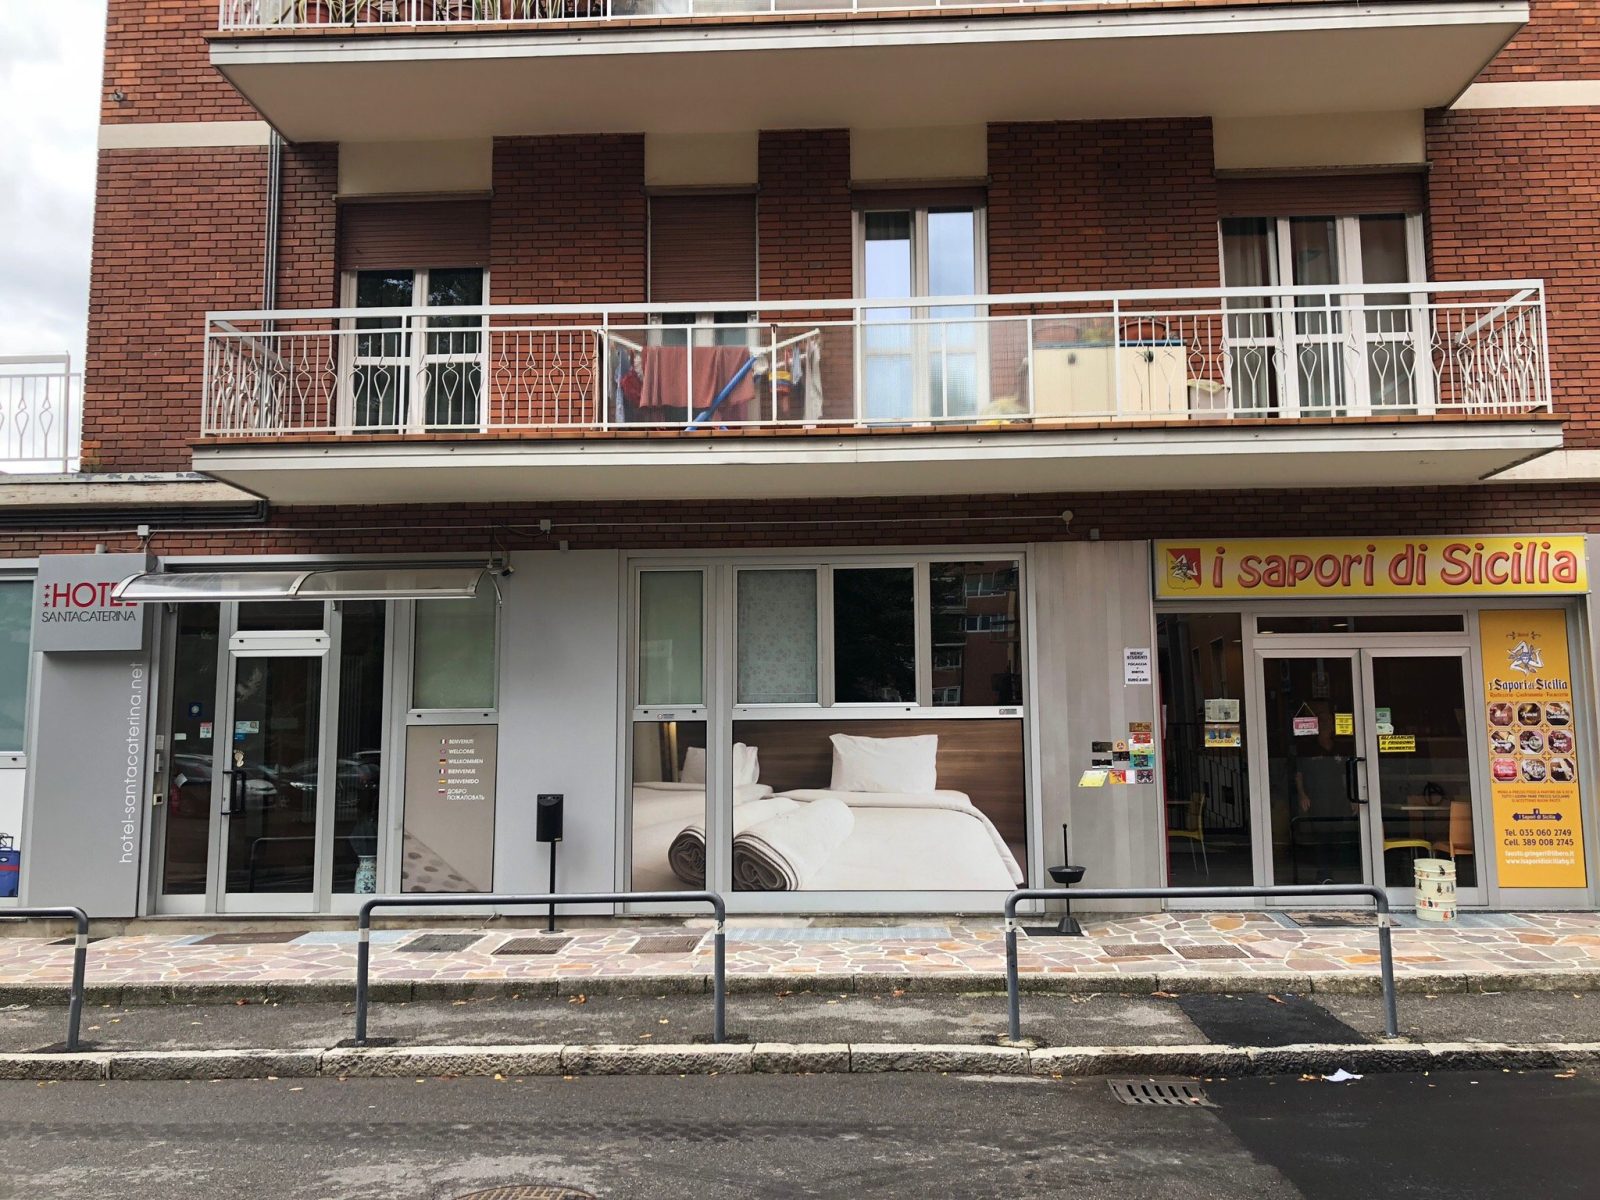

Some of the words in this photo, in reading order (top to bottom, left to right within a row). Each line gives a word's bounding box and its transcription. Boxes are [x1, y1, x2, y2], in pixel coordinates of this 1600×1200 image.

[1212, 546, 1226, 588] i
[1237, 544, 1376, 588] sapori
[1388, 543, 1428, 587] di
[1440, 541, 1578, 586] Sicilia
[41, 610, 137, 623] SANTACATERINA
[1494, 678, 1527, 693] Sapori
[1535, 678, 1568, 690] Sicilia
[119, 661, 144, 864] hotel-santacaterina.net
[1519, 829, 1534, 837] 035
[1536, 829, 1552, 837] 060
[1554, 829, 1572, 837] 2749
[1503, 838, 1520, 846] Cell.
[1522, 838, 1537, 846] 389
[1538, 838, 1554, 846] 008
[1556, 838, 1574, 846] 2745
